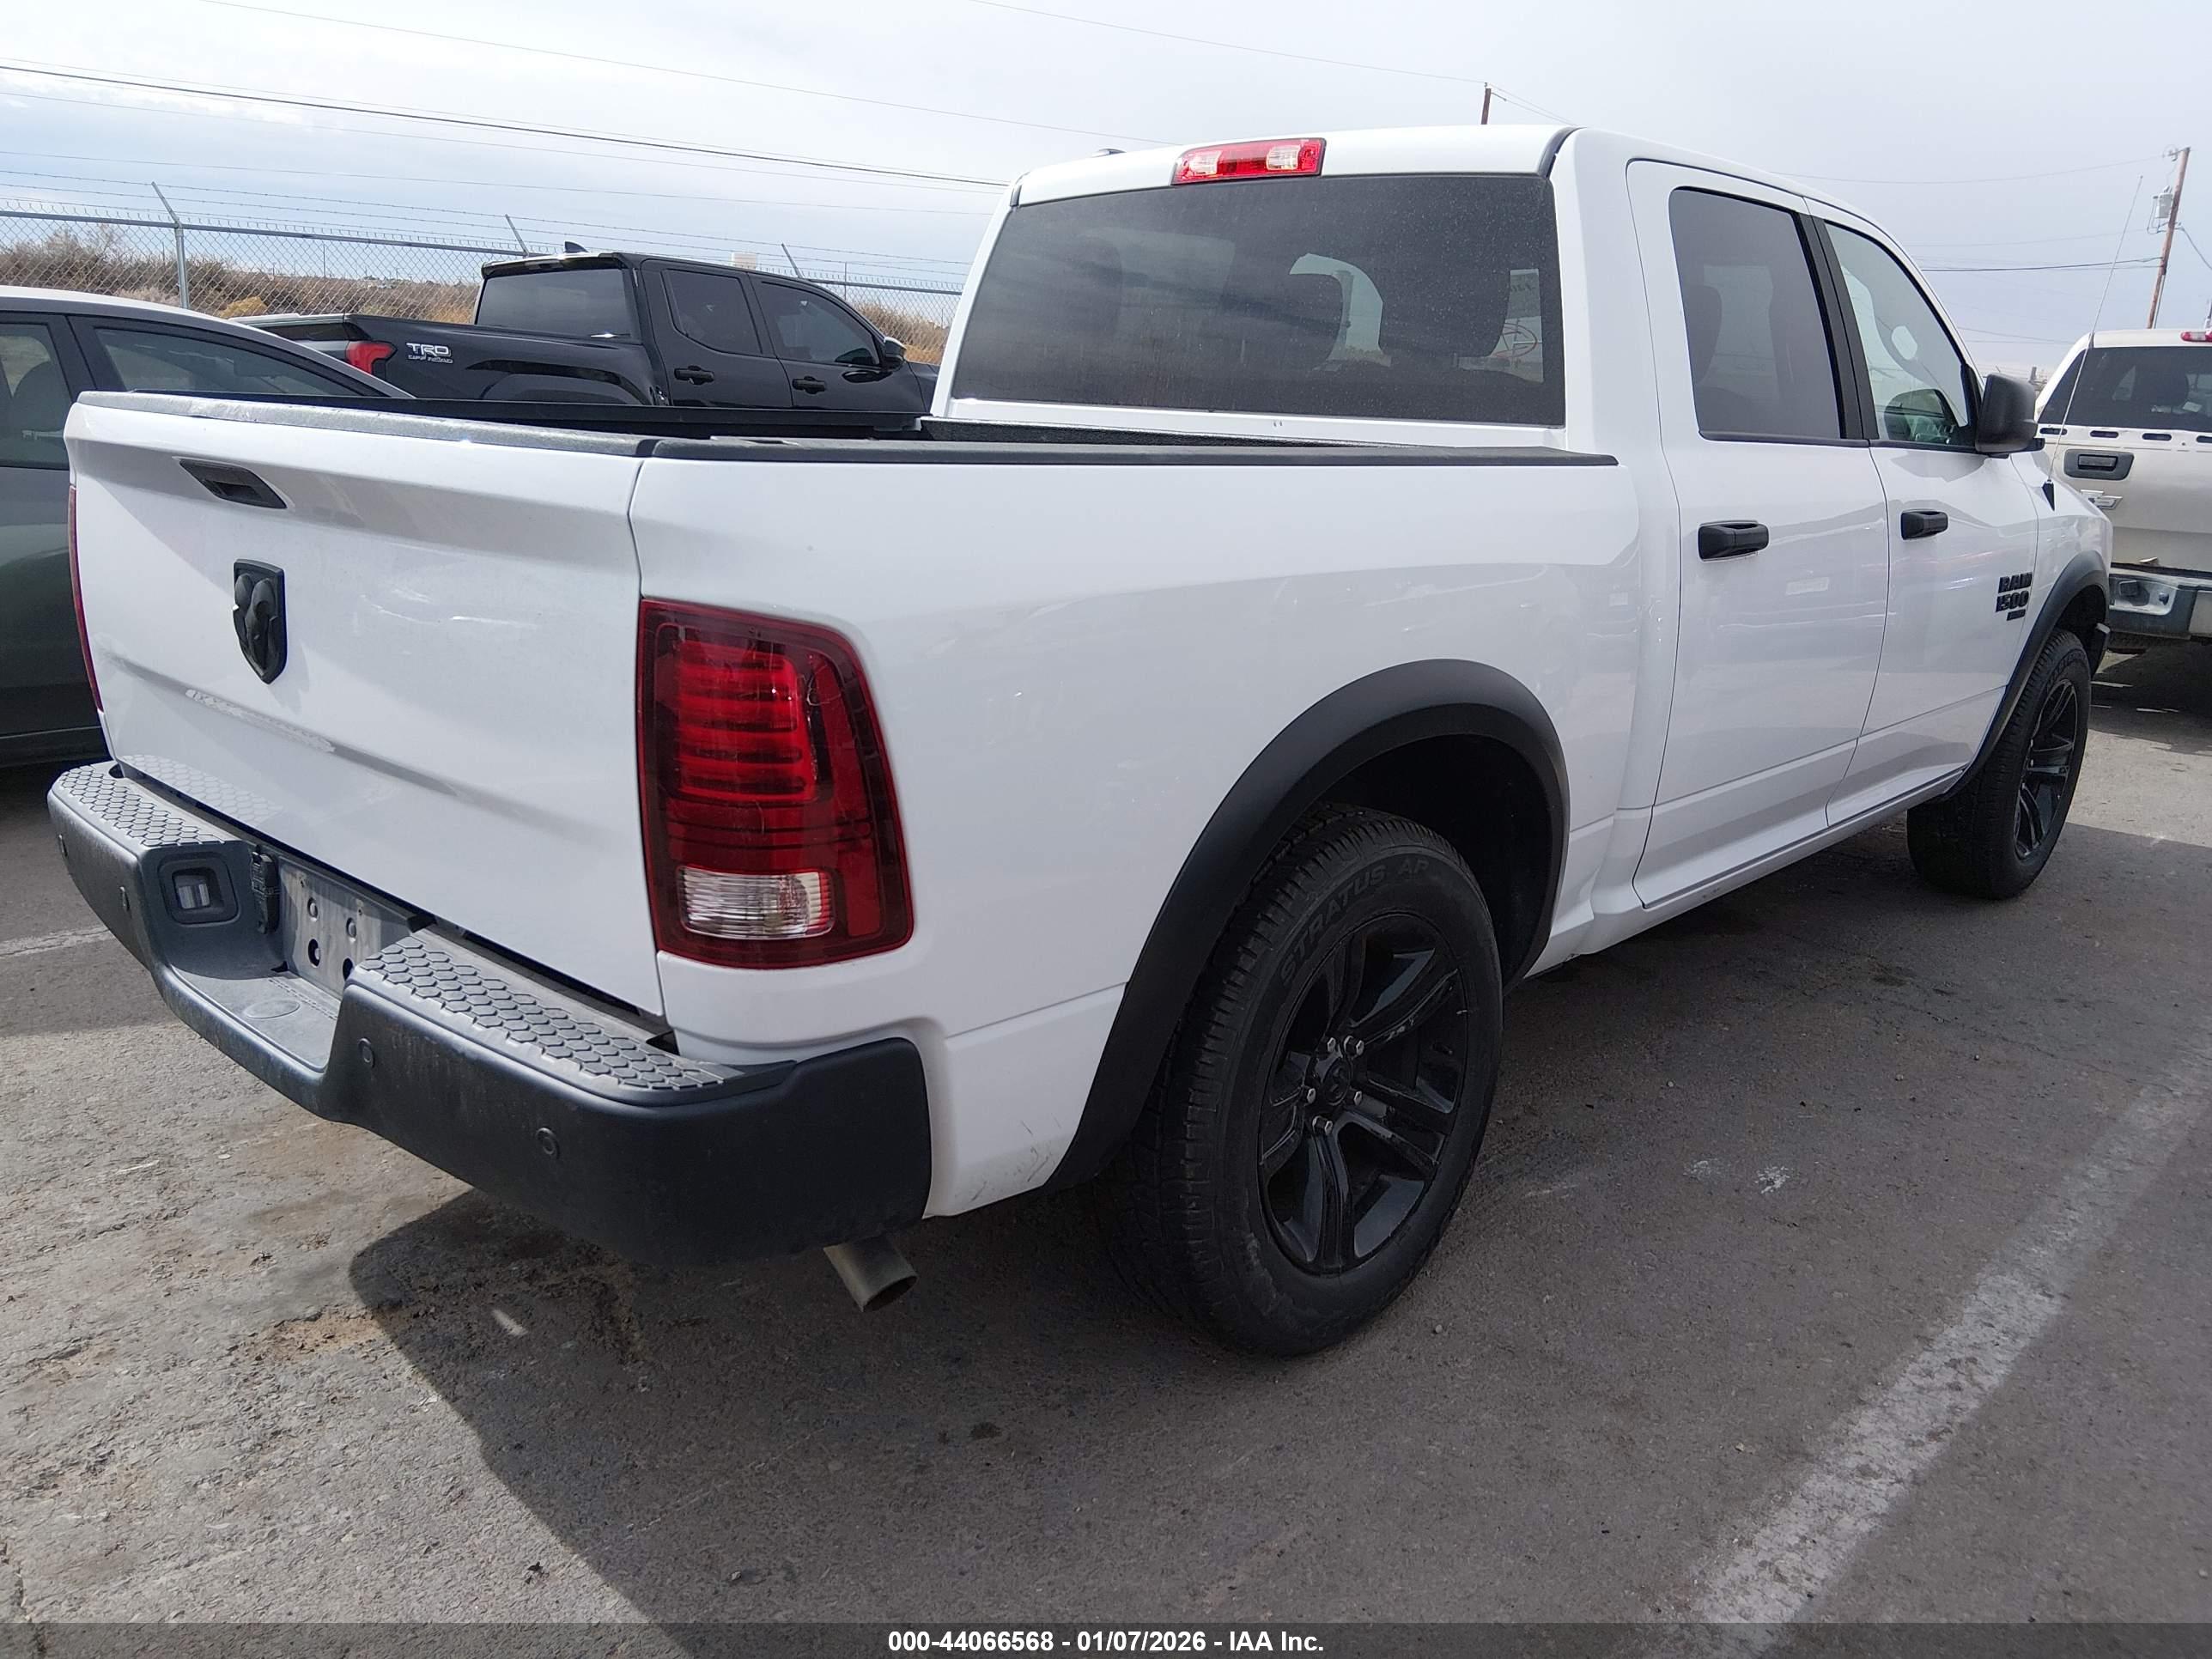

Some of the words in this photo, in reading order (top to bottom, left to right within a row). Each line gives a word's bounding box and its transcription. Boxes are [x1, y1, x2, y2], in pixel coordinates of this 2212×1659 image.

[406, 342, 452, 357] TRD
[1996, 591, 2029, 612] 1500
[1279, 864, 1388, 988] STRATUS
[1397, 858, 1431, 876] AP
